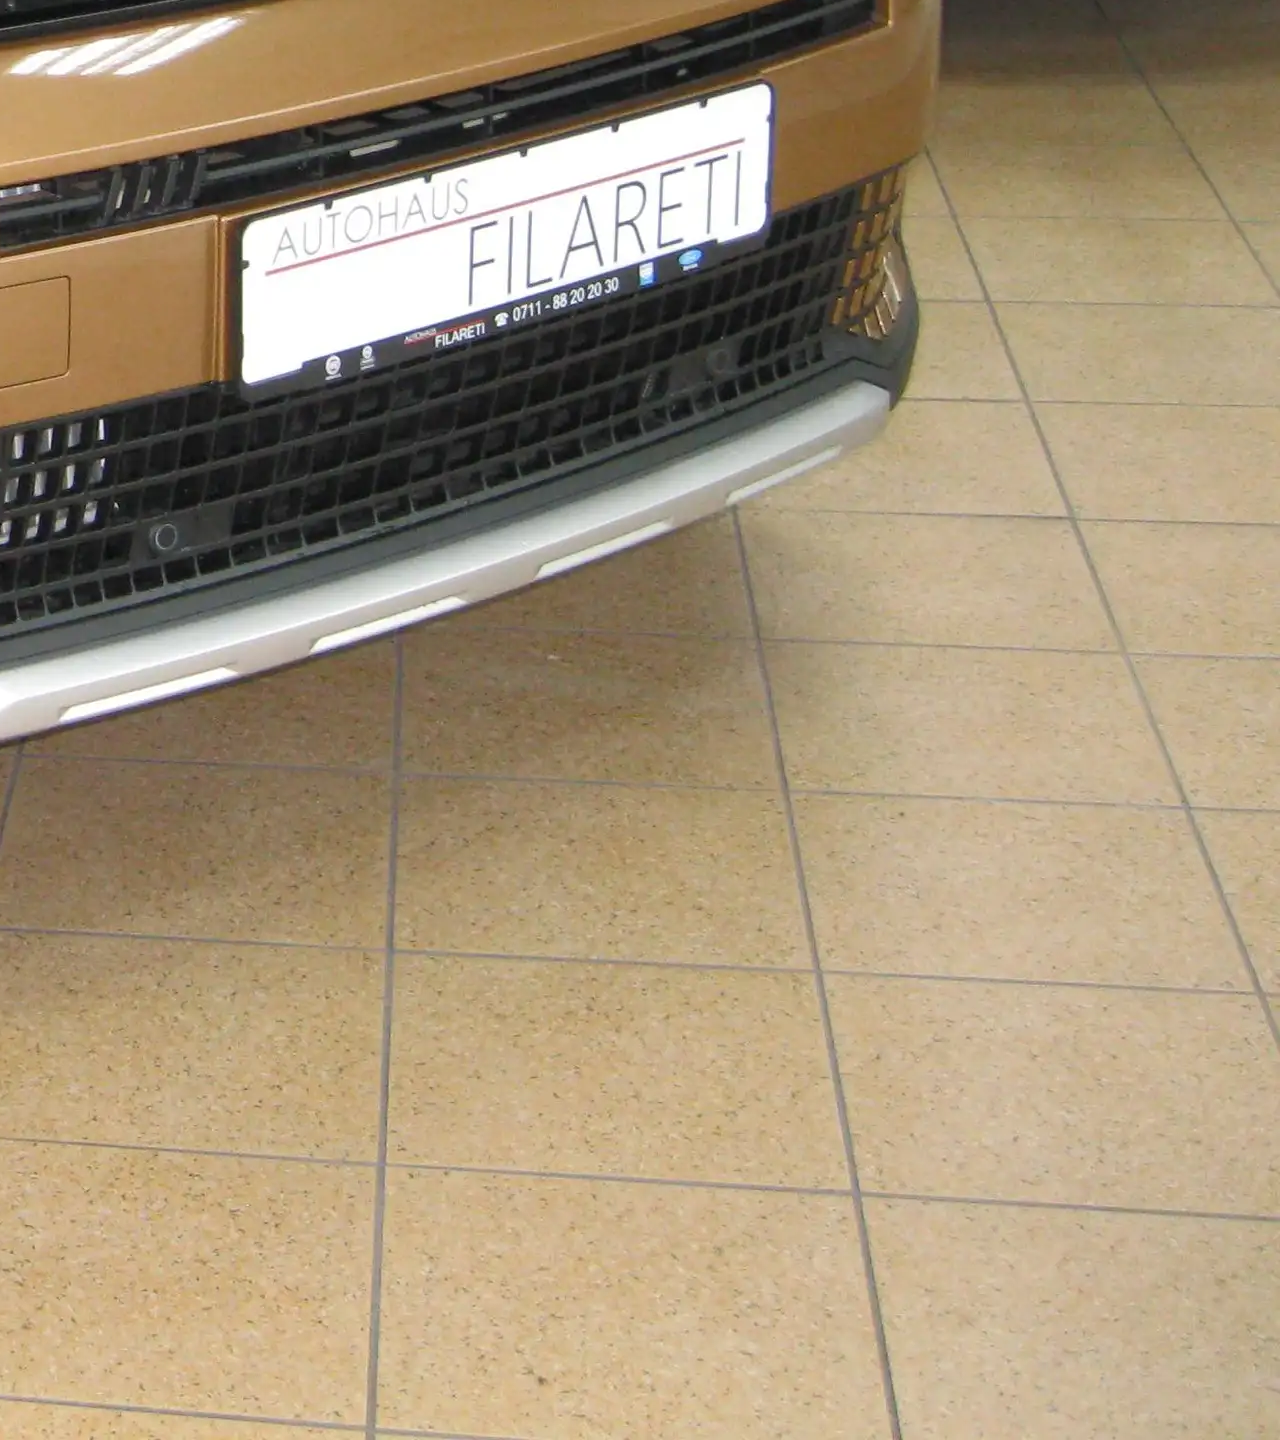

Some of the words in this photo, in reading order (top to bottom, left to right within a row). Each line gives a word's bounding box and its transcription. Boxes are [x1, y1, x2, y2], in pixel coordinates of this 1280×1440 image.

[272, 178, 469, 265] AUTOHAUS
[468, 150, 743, 307] FILARETI
[434, 322, 486, 349] FILARETI
[512, 300, 542, 323] 0711
[552, 294, 568, 310] 88
[569, 288, 585, 305] 20
[587, 282, 603, 300] 20
[604, 276, 620, 294] 30
